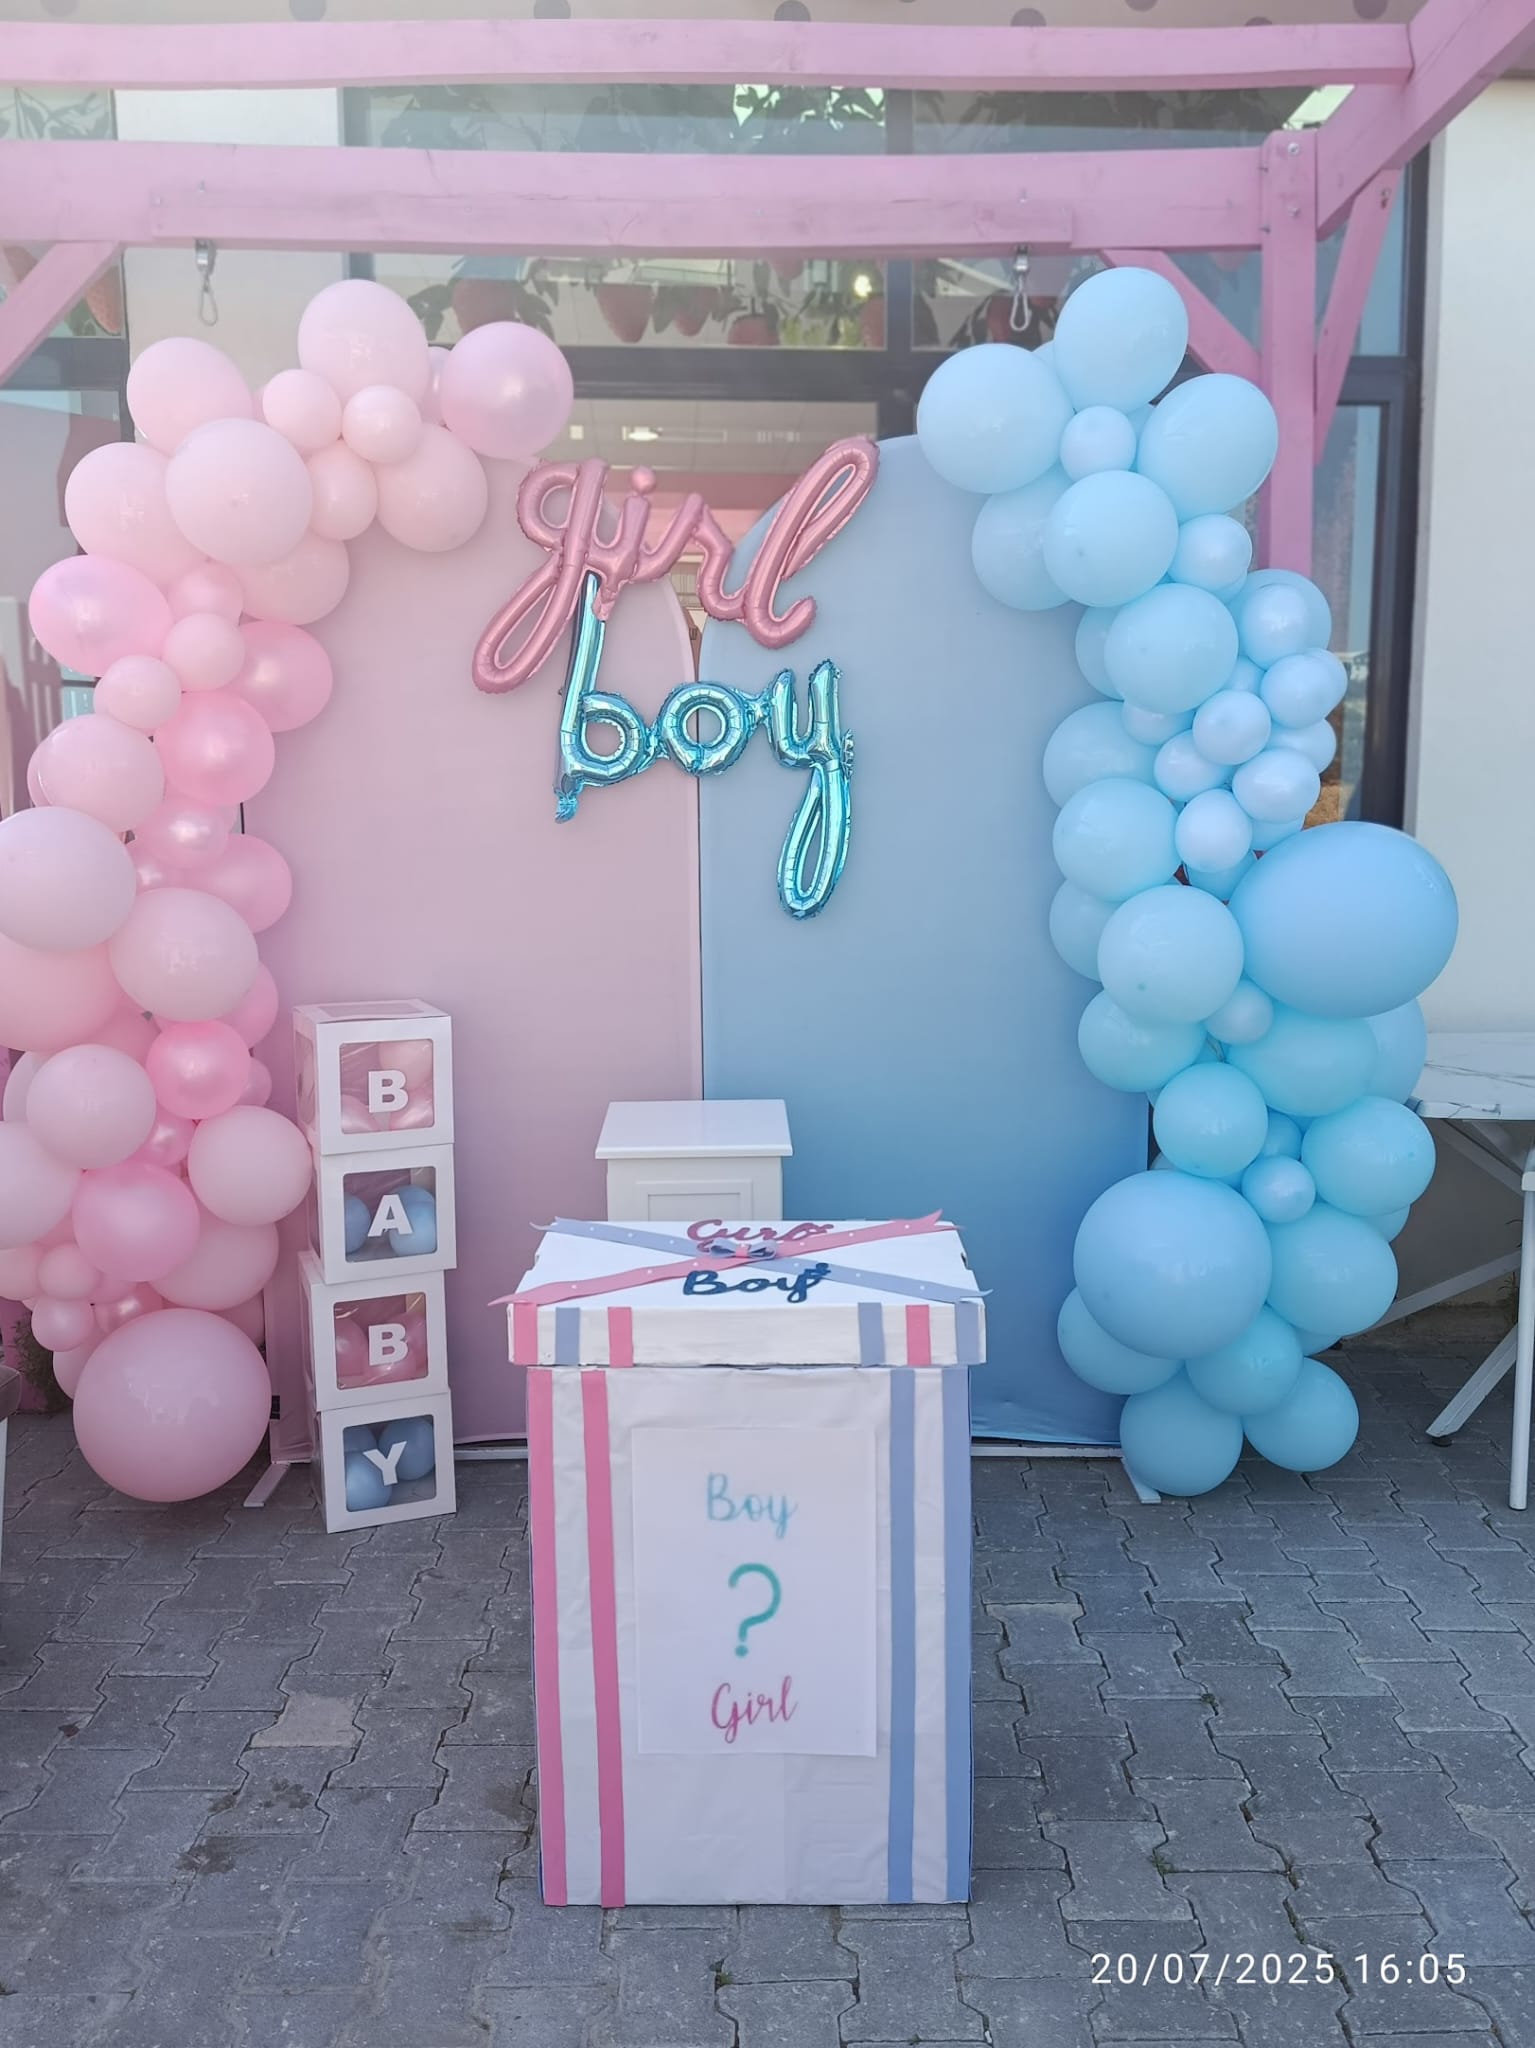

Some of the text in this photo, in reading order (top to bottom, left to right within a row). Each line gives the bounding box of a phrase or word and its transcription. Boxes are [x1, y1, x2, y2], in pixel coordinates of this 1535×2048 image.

[471, 435, 879, 694] girl
[553, 570, 853, 919] boy
[683, 1262, 831, 1303] Boy
[706, 1472, 798, 1540] Boy
[728, 1563, 782, 1658] ?
[710, 1675, 798, 1744] Girl
